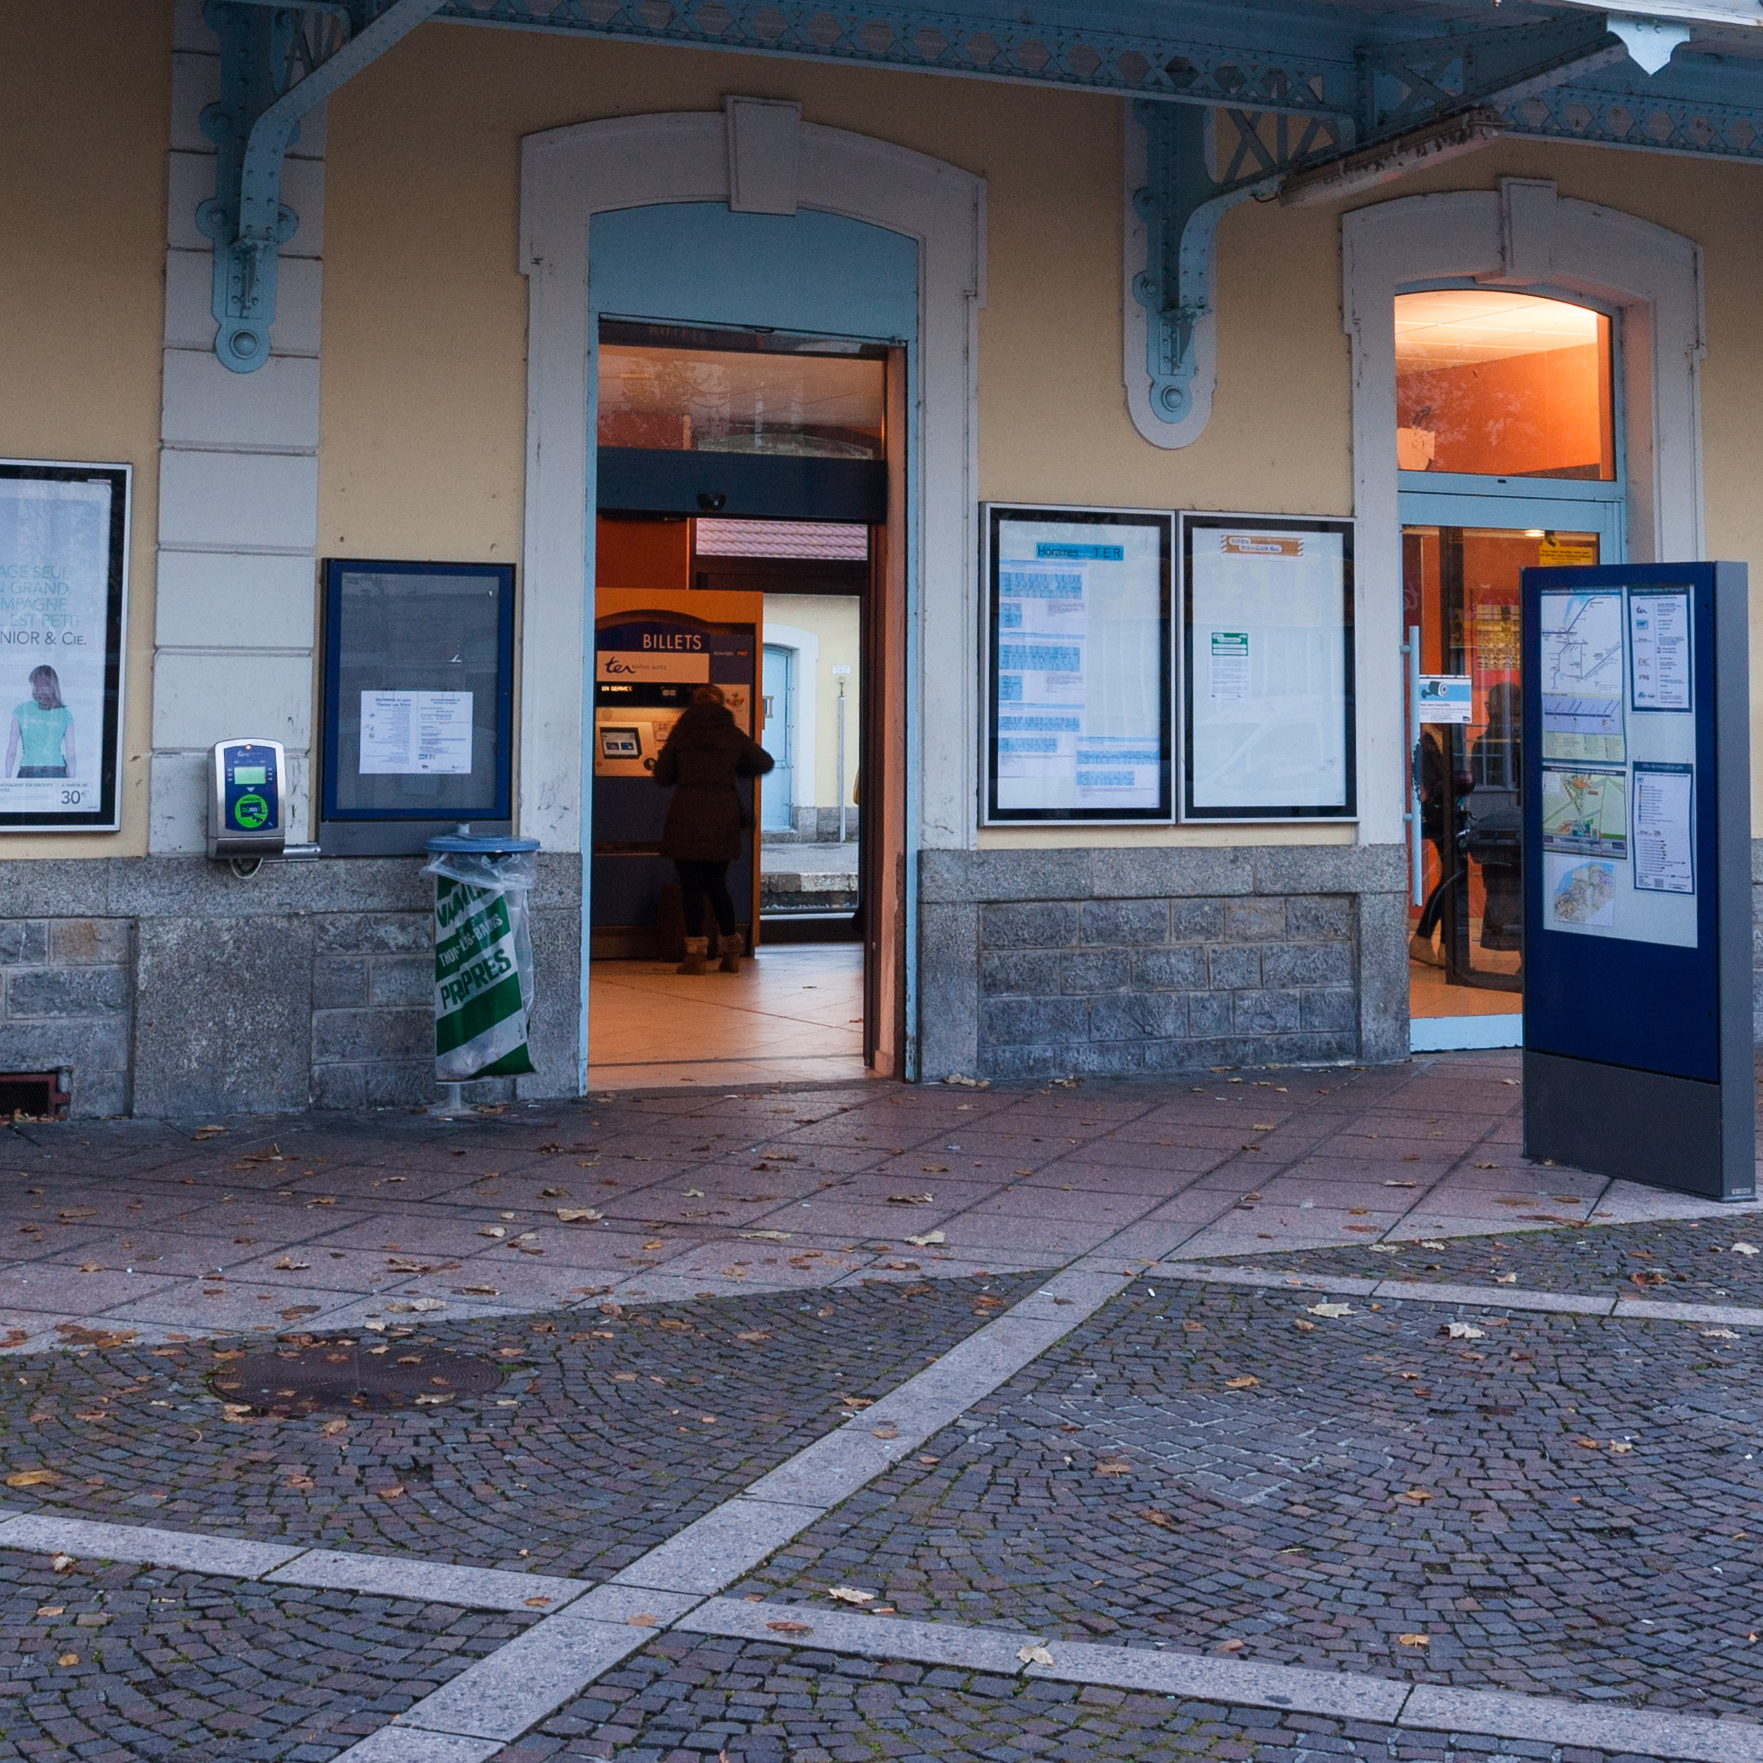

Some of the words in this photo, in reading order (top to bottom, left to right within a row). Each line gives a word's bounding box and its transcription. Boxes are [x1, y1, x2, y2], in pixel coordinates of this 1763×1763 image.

[1037, 546, 1078, 557] Horaires
[33, 565, 70, 580] SEUL
[44, 631, 56, 645] &
[643, 634, 702, 650] BILLETS
[604, 656, 636, 674] ter
